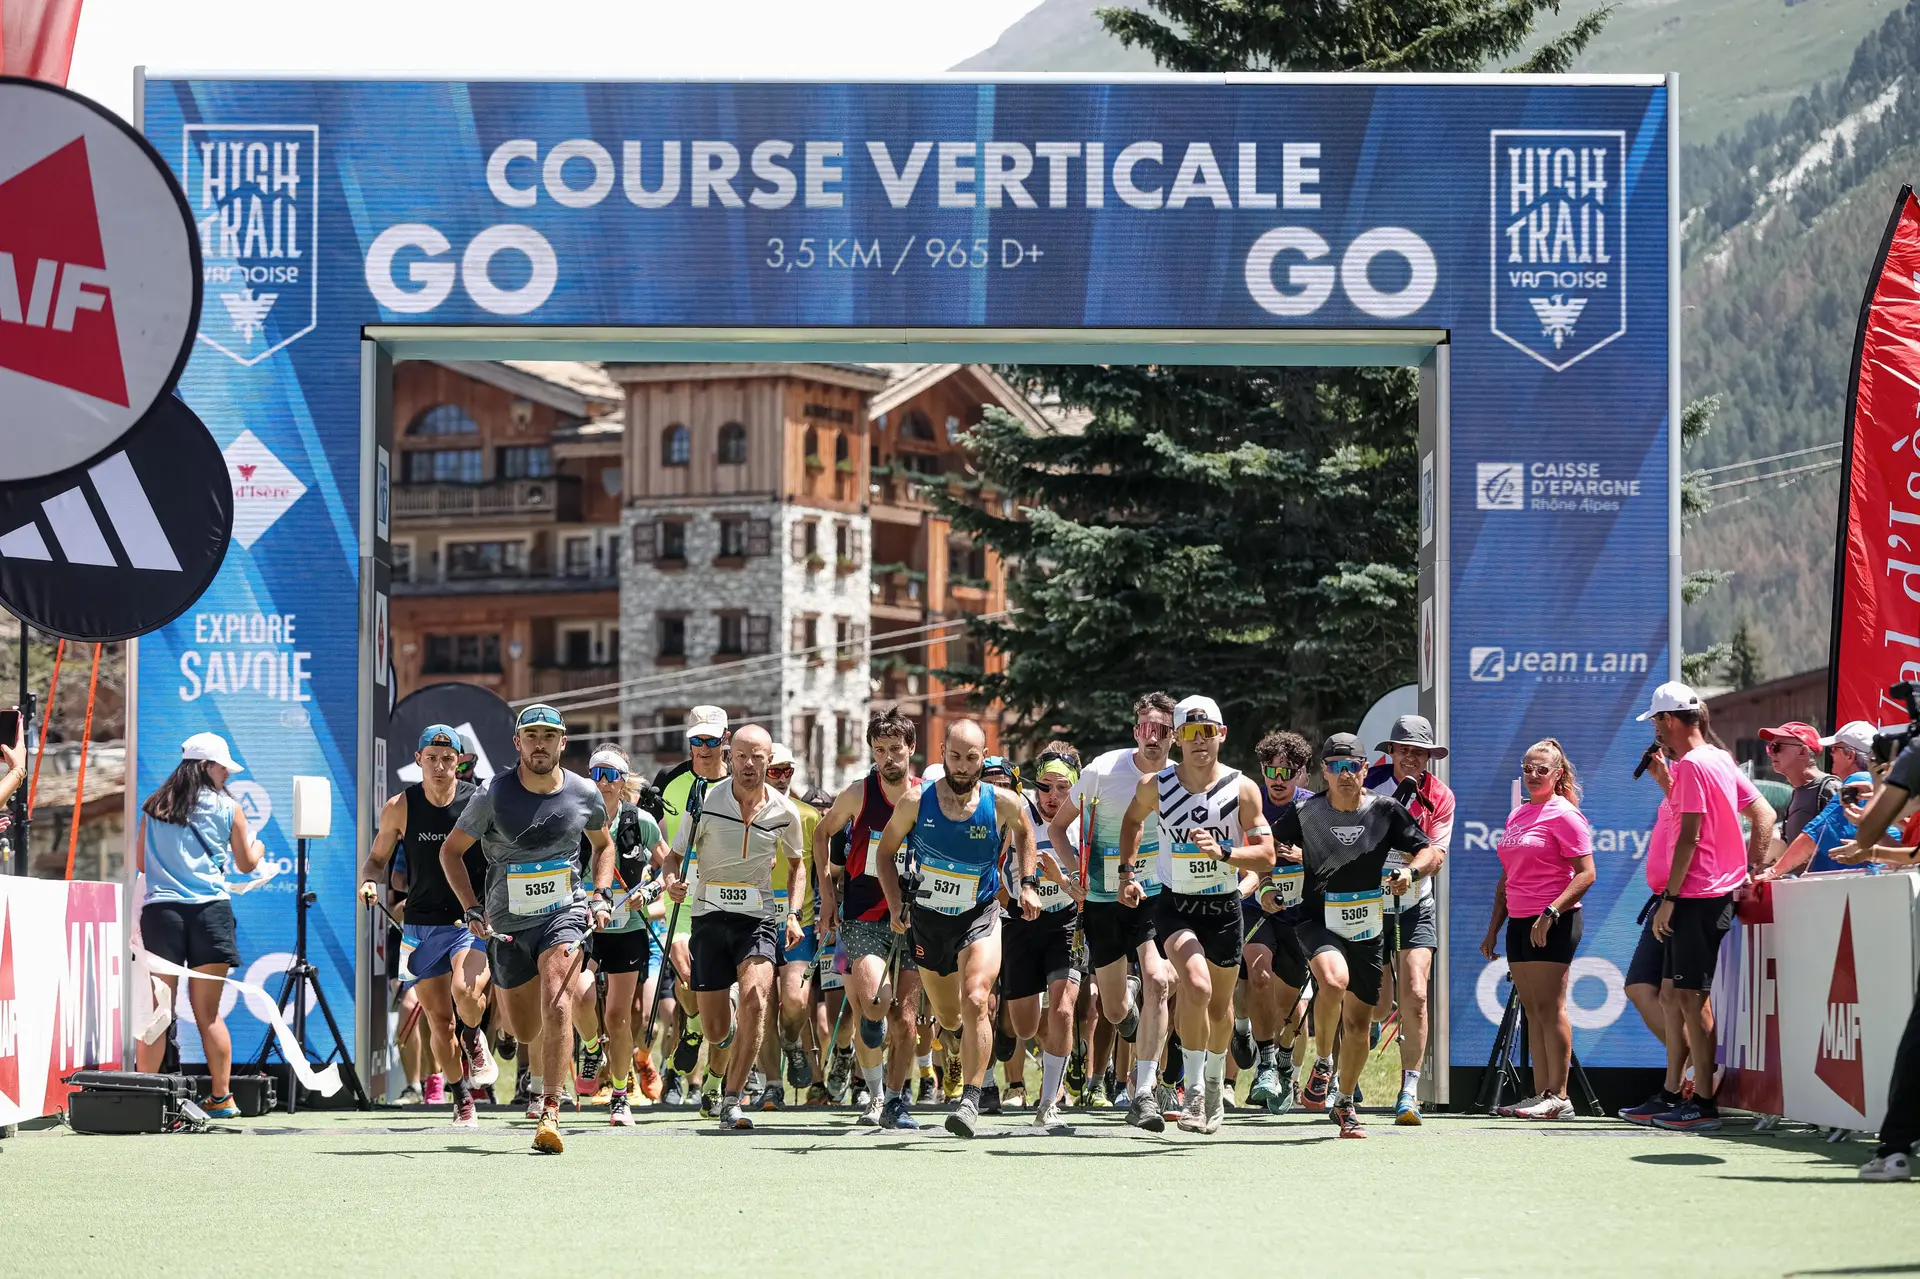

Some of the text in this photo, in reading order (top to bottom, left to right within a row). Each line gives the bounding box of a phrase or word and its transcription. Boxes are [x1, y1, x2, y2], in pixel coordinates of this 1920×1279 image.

[201, 141, 300, 209] HIGH
[486, 138, 1322, 211] COURSE VERTICALE
[1508, 147, 1608, 216] HIGH
[198, 194, 303, 259] TRAIL
[1506, 199, 1612, 264] TRAIL
[766, 237, 816, 273] 3,5
[828, 238, 882, 269] KM
[925, 238, 989, 269] 965
[1001, 238, 1045, 269] D+
[365, 223, 558, 315] GO
[1244, 226, 1438, 318] GO
[1530, 462, 1600, 478] CAISSE
[1531, 480, 1642, 496] D'EPARGNE
[1531, 498, 1620, 513] Rhône Alpes
[195, 613, 296, 644] EXPLORE
[1506, 651, 1649, 673] Jean Lain
[178, 650, 312, 702] SAVOIE
[1133, 859, 1146, 869] 42
[1189, 860, 1218, 874] 5314
[525, 880, 556, 897] 5352
[720, 888, 747, 901] 5333
[934, 879, 961, 896] 5371
[1274, 881, 1294, 892] 357
[1341, 906, 1369, 921] 5305
[1822, 1003, 1860, 1060] MAIF
[1681, 1111, 1701, 1121] HOKA
